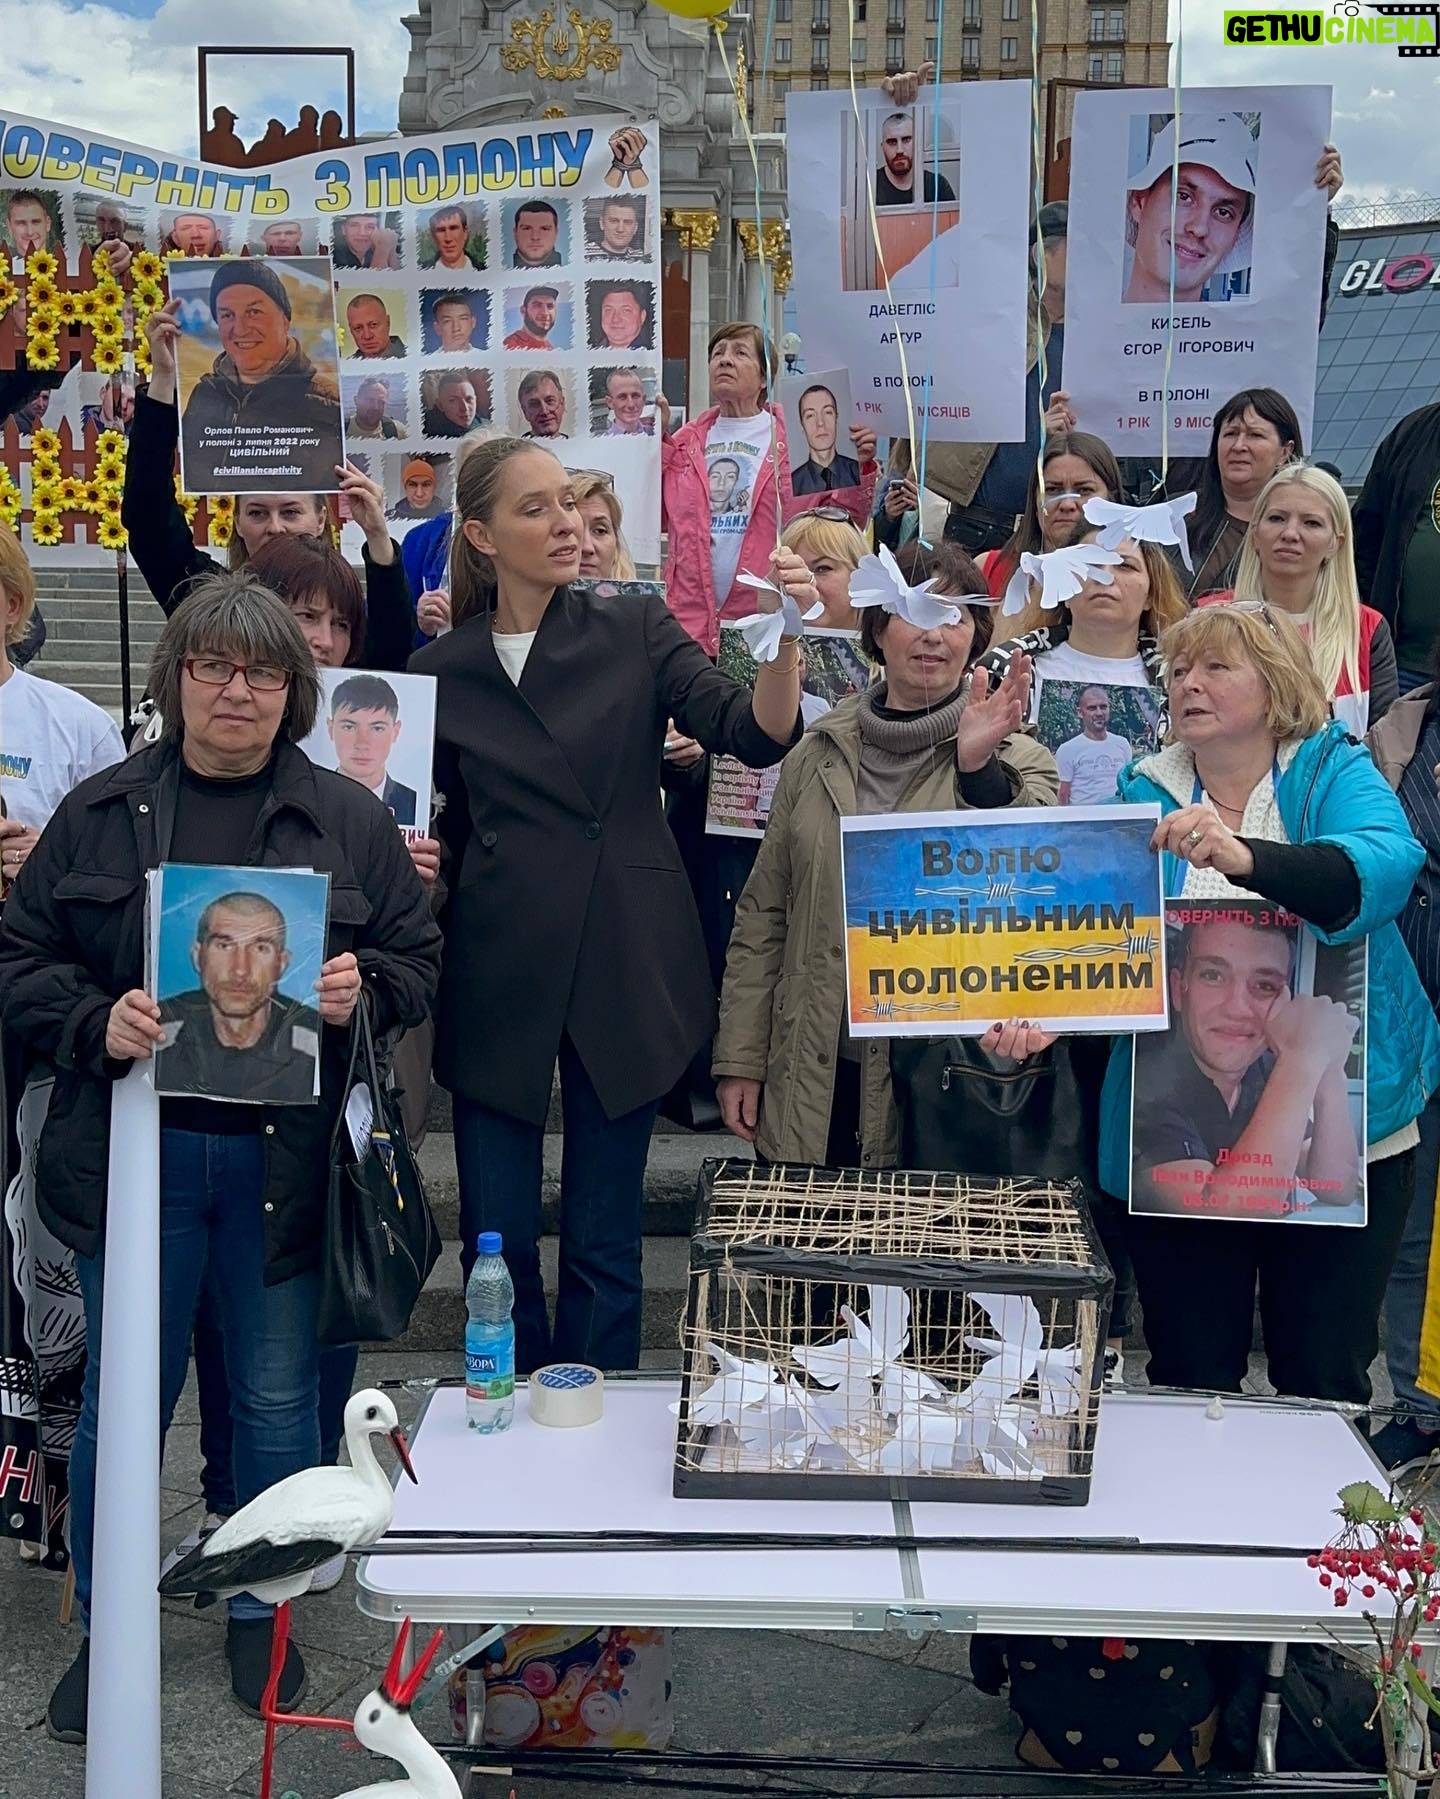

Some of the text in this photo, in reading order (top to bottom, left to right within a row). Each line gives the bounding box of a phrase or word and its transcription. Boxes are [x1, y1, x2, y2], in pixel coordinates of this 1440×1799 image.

[0, 121, 594, 215] ОВЕРНІТЬ З ПОЛОНУ
[868, 302, 936, 318] ДАВЕГЛІС
[1151, 316, 1211, 330] КИСЕЛЬ
[880, 332, 923, 344] АРТУР
[1123, 340, 1255, 356] ЄГОР ІГОРОВИЧ
[873, 376, 882, 388] В
[1138, 388, 1210, 402] В ПОЛОНІ
[855, 401, 862, 413] 1
[864, 403, 883, 415] РІК
[917, 406, 971, 419] МІСЯЦІВ
[1116, 417, 1215, 429] 1 РІК 9 МІС
[204, 427, 233, 436] Орлов
[234, 426, 262, 435] Павло
[205, 438, 235, 447] полоні
[274, 437, 298, 446] 2022
[299, 437, 321, 447] року
[213, 466, 303, 476] #civiliansincaptivity
[710, 515, 749, 528] ЛЬНИХ
[921, 840, 1061, 877] Волю
[868, 898, 1135, 944] цивільним
[1166, 909, 1256, 926] ОВЕРНІТЬ
[868, 961, 1153, 995] полоненим
[1215, 1148, 1274, 1168] Дрозд
